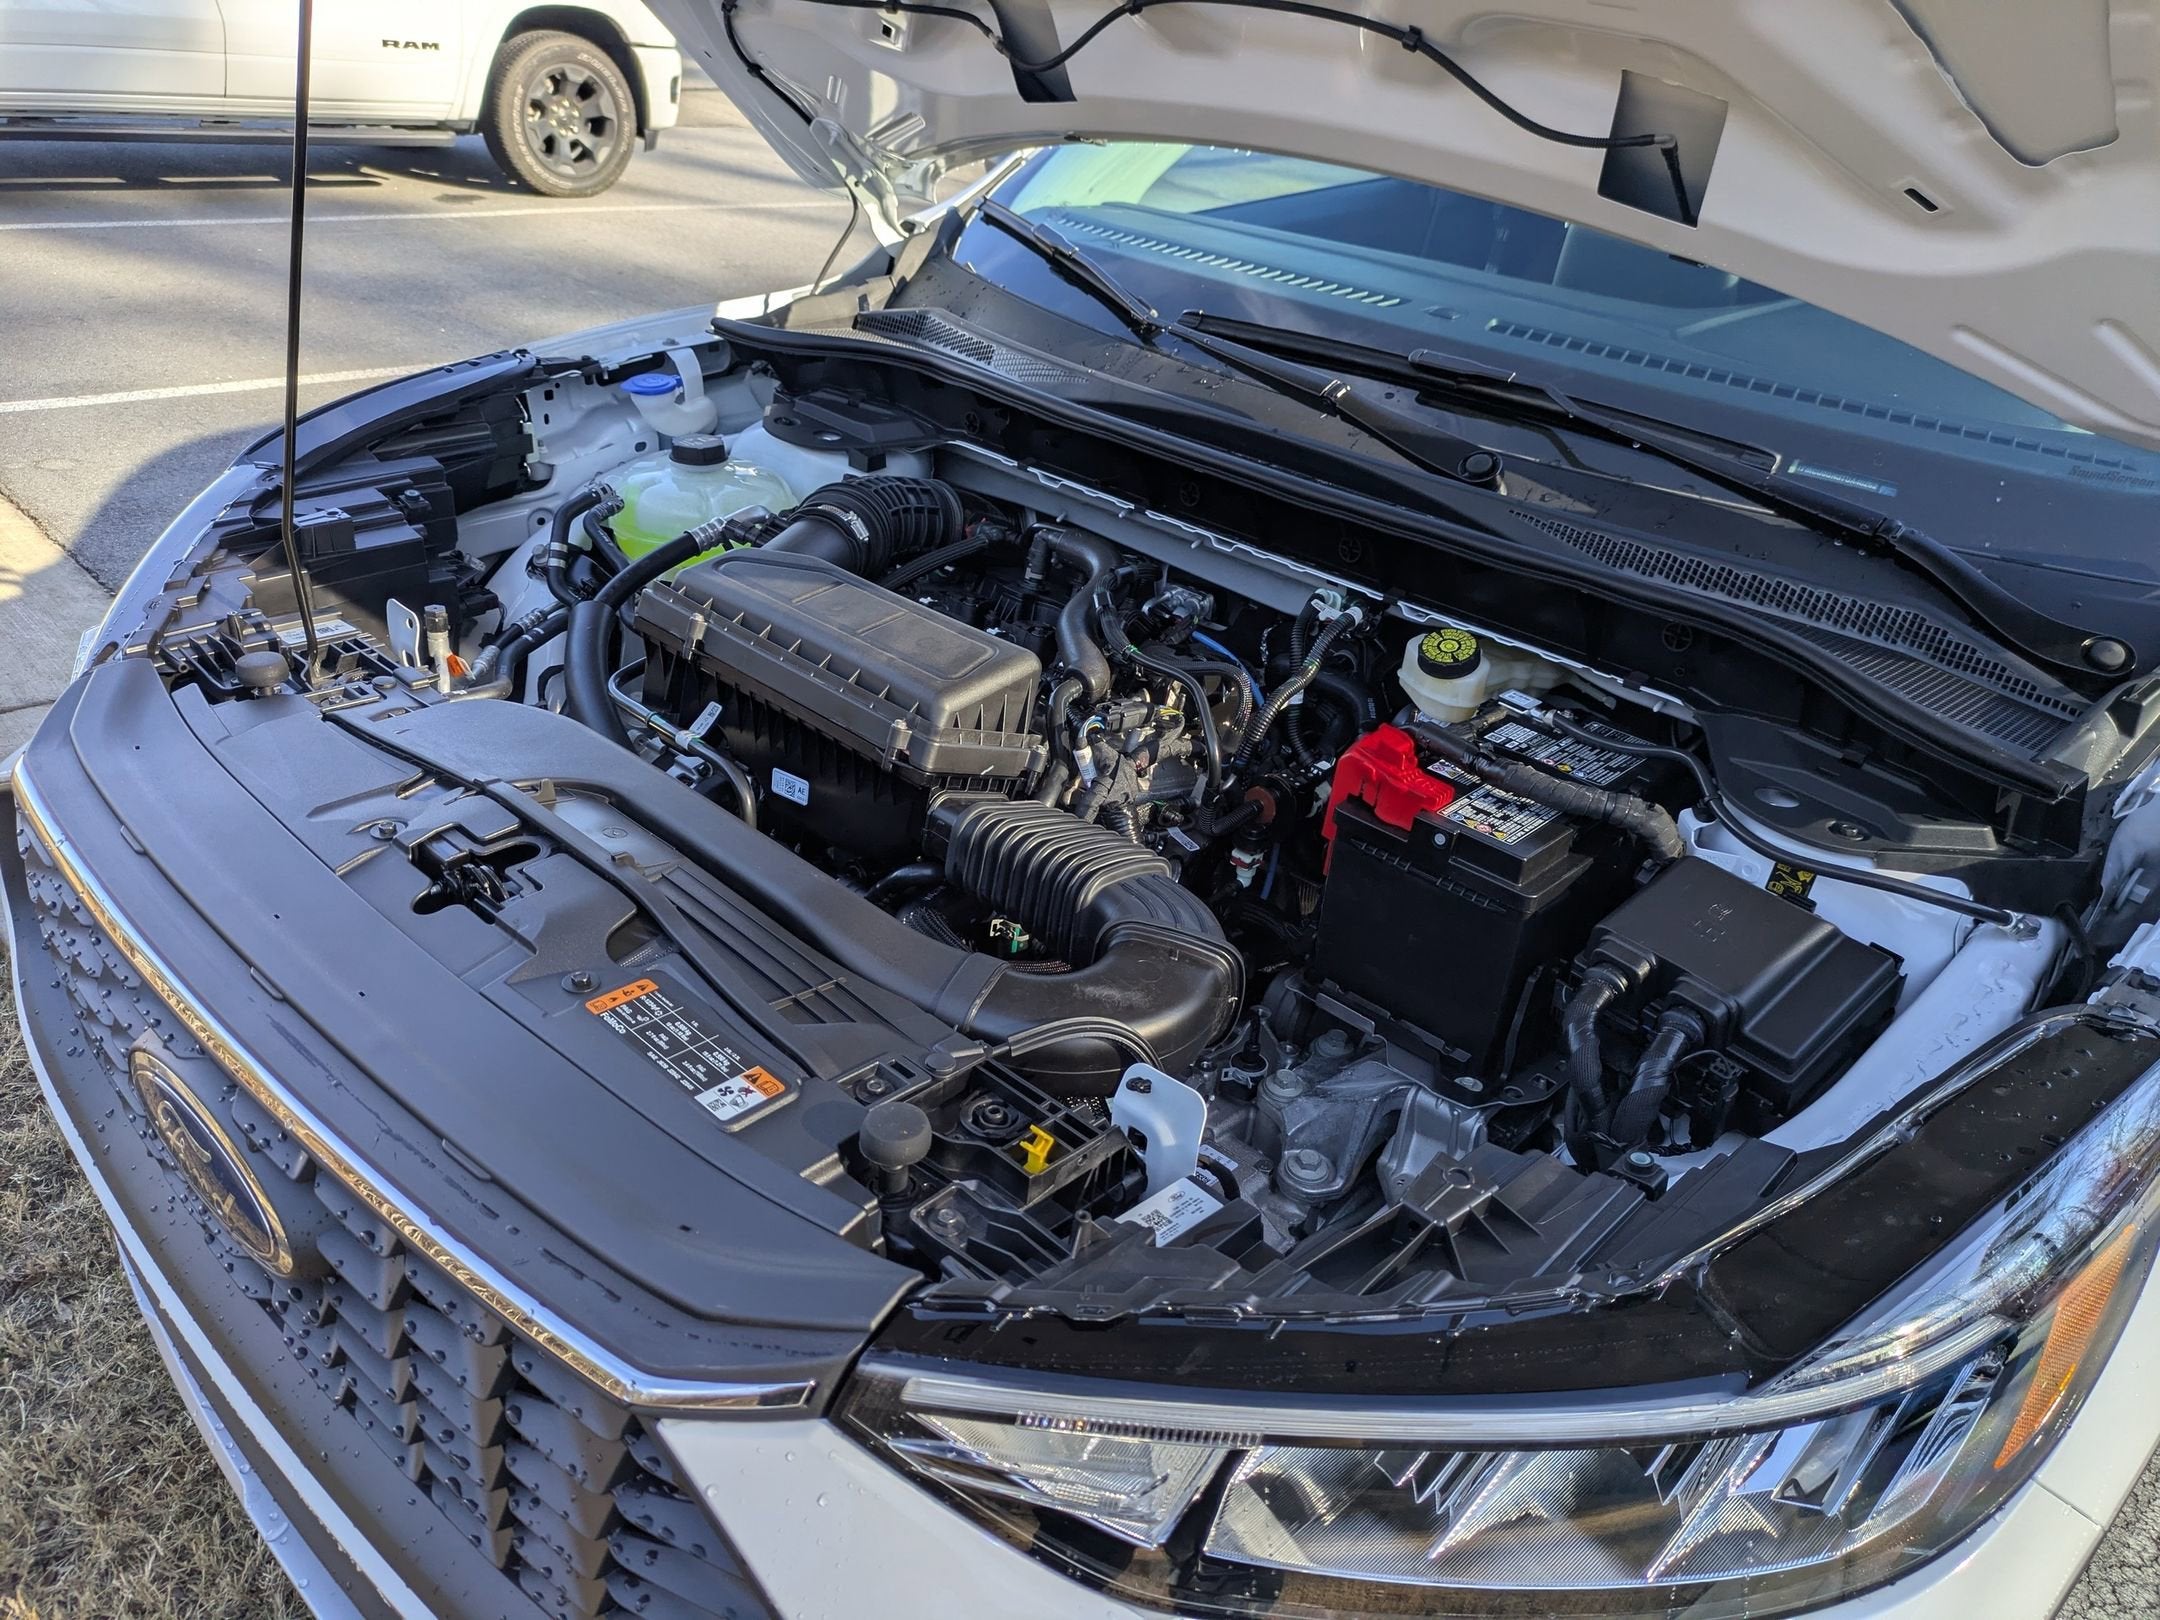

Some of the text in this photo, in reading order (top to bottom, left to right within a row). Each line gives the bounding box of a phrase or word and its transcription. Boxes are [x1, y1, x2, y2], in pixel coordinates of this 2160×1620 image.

[381, 38, 440, 51] RAM
[2068, 464, 2157, 489] SoundScreen
[599, 1012, 626, 1034] FoMoCo
[157, 1100, 237, 1228] Ford
